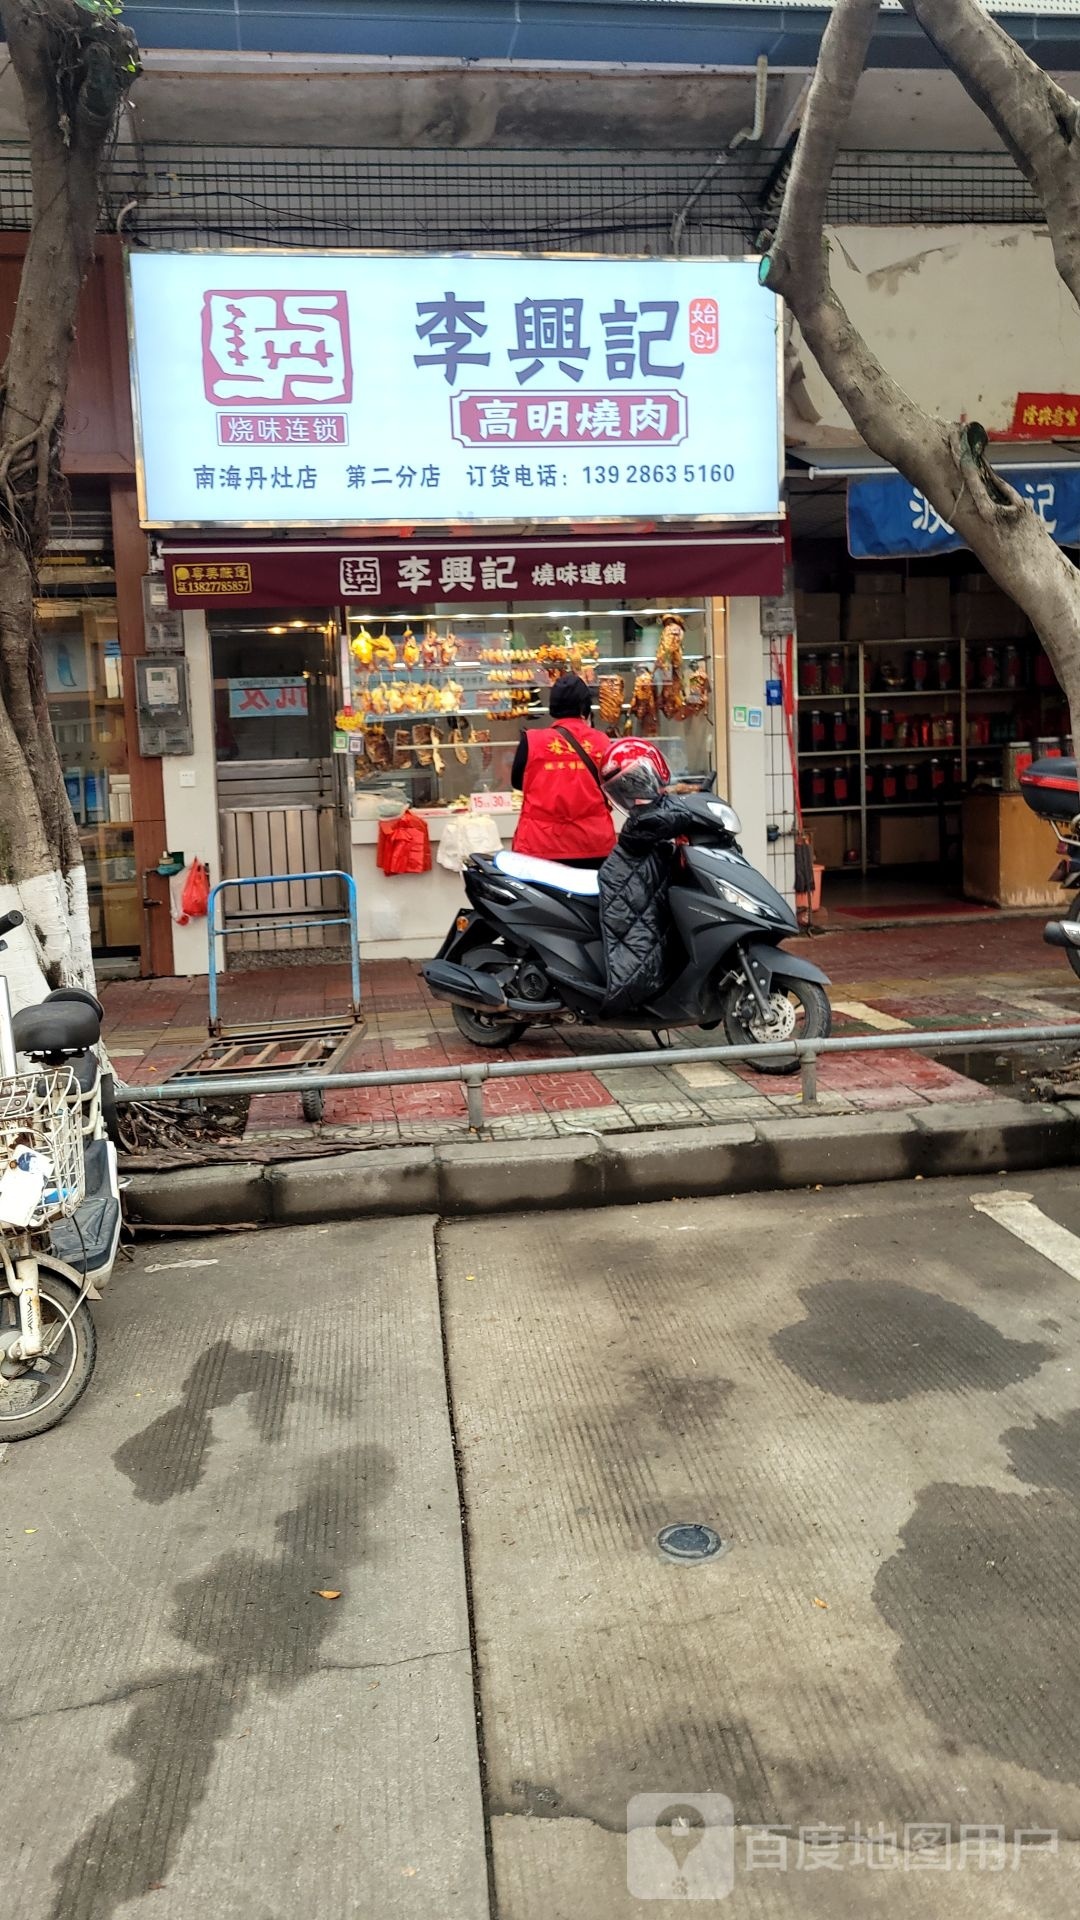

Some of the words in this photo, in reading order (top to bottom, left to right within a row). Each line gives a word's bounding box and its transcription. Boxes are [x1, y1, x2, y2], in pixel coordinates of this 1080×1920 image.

[413, 291, 685, 386] 李興記
[691, 302, 718, 350] 始创
[227, 417, 339, 442] 烧味连锁
[476, 398, 668, 439] 高明燒肉
[193, 464, 318, 490] 南海丹灶店
[345, 463, 441, 490] 第二分店
[582, 464, 620, 484] 139
[625, 464, 677, 483] 2863
[683, 463, 735, 483] 5160
[188, 580, 249, 593] 13827785857
[397, 556, 519, 594] 李興記
[531, 561, 627, 587] 燒味連鎖
